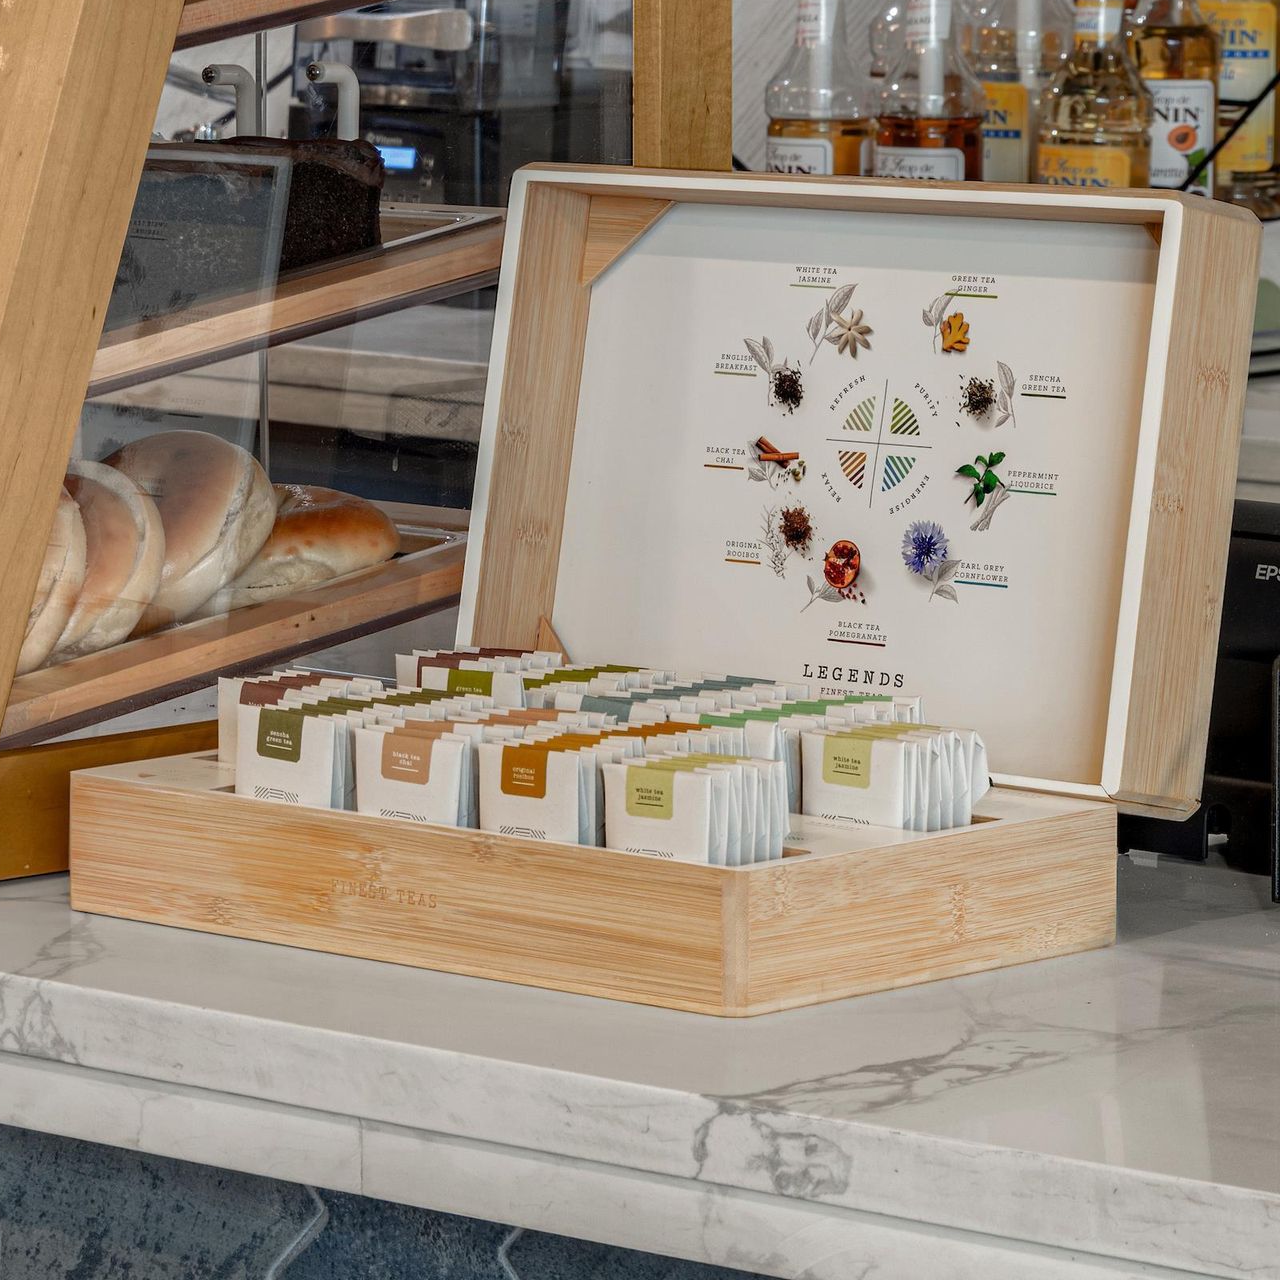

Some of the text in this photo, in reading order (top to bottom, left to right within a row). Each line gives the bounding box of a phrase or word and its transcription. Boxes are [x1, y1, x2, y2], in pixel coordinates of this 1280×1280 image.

[796, 266, 837, 275] WHITE TEA
[798, 276, 831, 284] JASMINE
[952, 275, 978, 283] GREEN
[957, 285, 988, 293] GINGER
[721, 353, 754, 362] ENGLISH
[715, 363, 758, 371] BREAKFAST
[1029, 374, 1061, 383] SENCHA
[1022, 384, 1049, 392] GREEN
[830, 375, 866, 411] REFRESH
[914, 382, 938, 418] PURIFY
[706, 447, 746, 456] BLACK TEA
[1008, 470, 1060, 481] PEPPERMINT
[821, 472, 842, 503] RELAX
[1010, 480, 1054, 490] LIQUORICE
[889, 474, 930, 515] ENERGISE
[725, 540, 762, 550] ORIGINAL
[726, 550, 760, 559] ROOIBOS
[960, 562, 1005, 572] EARL GREY
[954, 571, 1009, 582] CORNFLOWER
[838, 621, 863, 629] BLACK
[828, 629, 888, 642] POMEGRANATE
[802, 663, 905, 688] LEGENDS
[820, 687, 854, 697] FINEST
[269, 730, 290, 739] sencha
[265, 736, 293, 746] green tea
[392, 750, 410, 760] black
[833, 755, 850, 764] white
[398, 759, 413, 767] chai
[834, 762, 860, 771] jasmine
[512, 767, 536, 775] original
[635, 786, 664, 796] white tea
[637, 794, 662, 802] jasmine
[330, 879, 438, 909] FINEST TEAS
